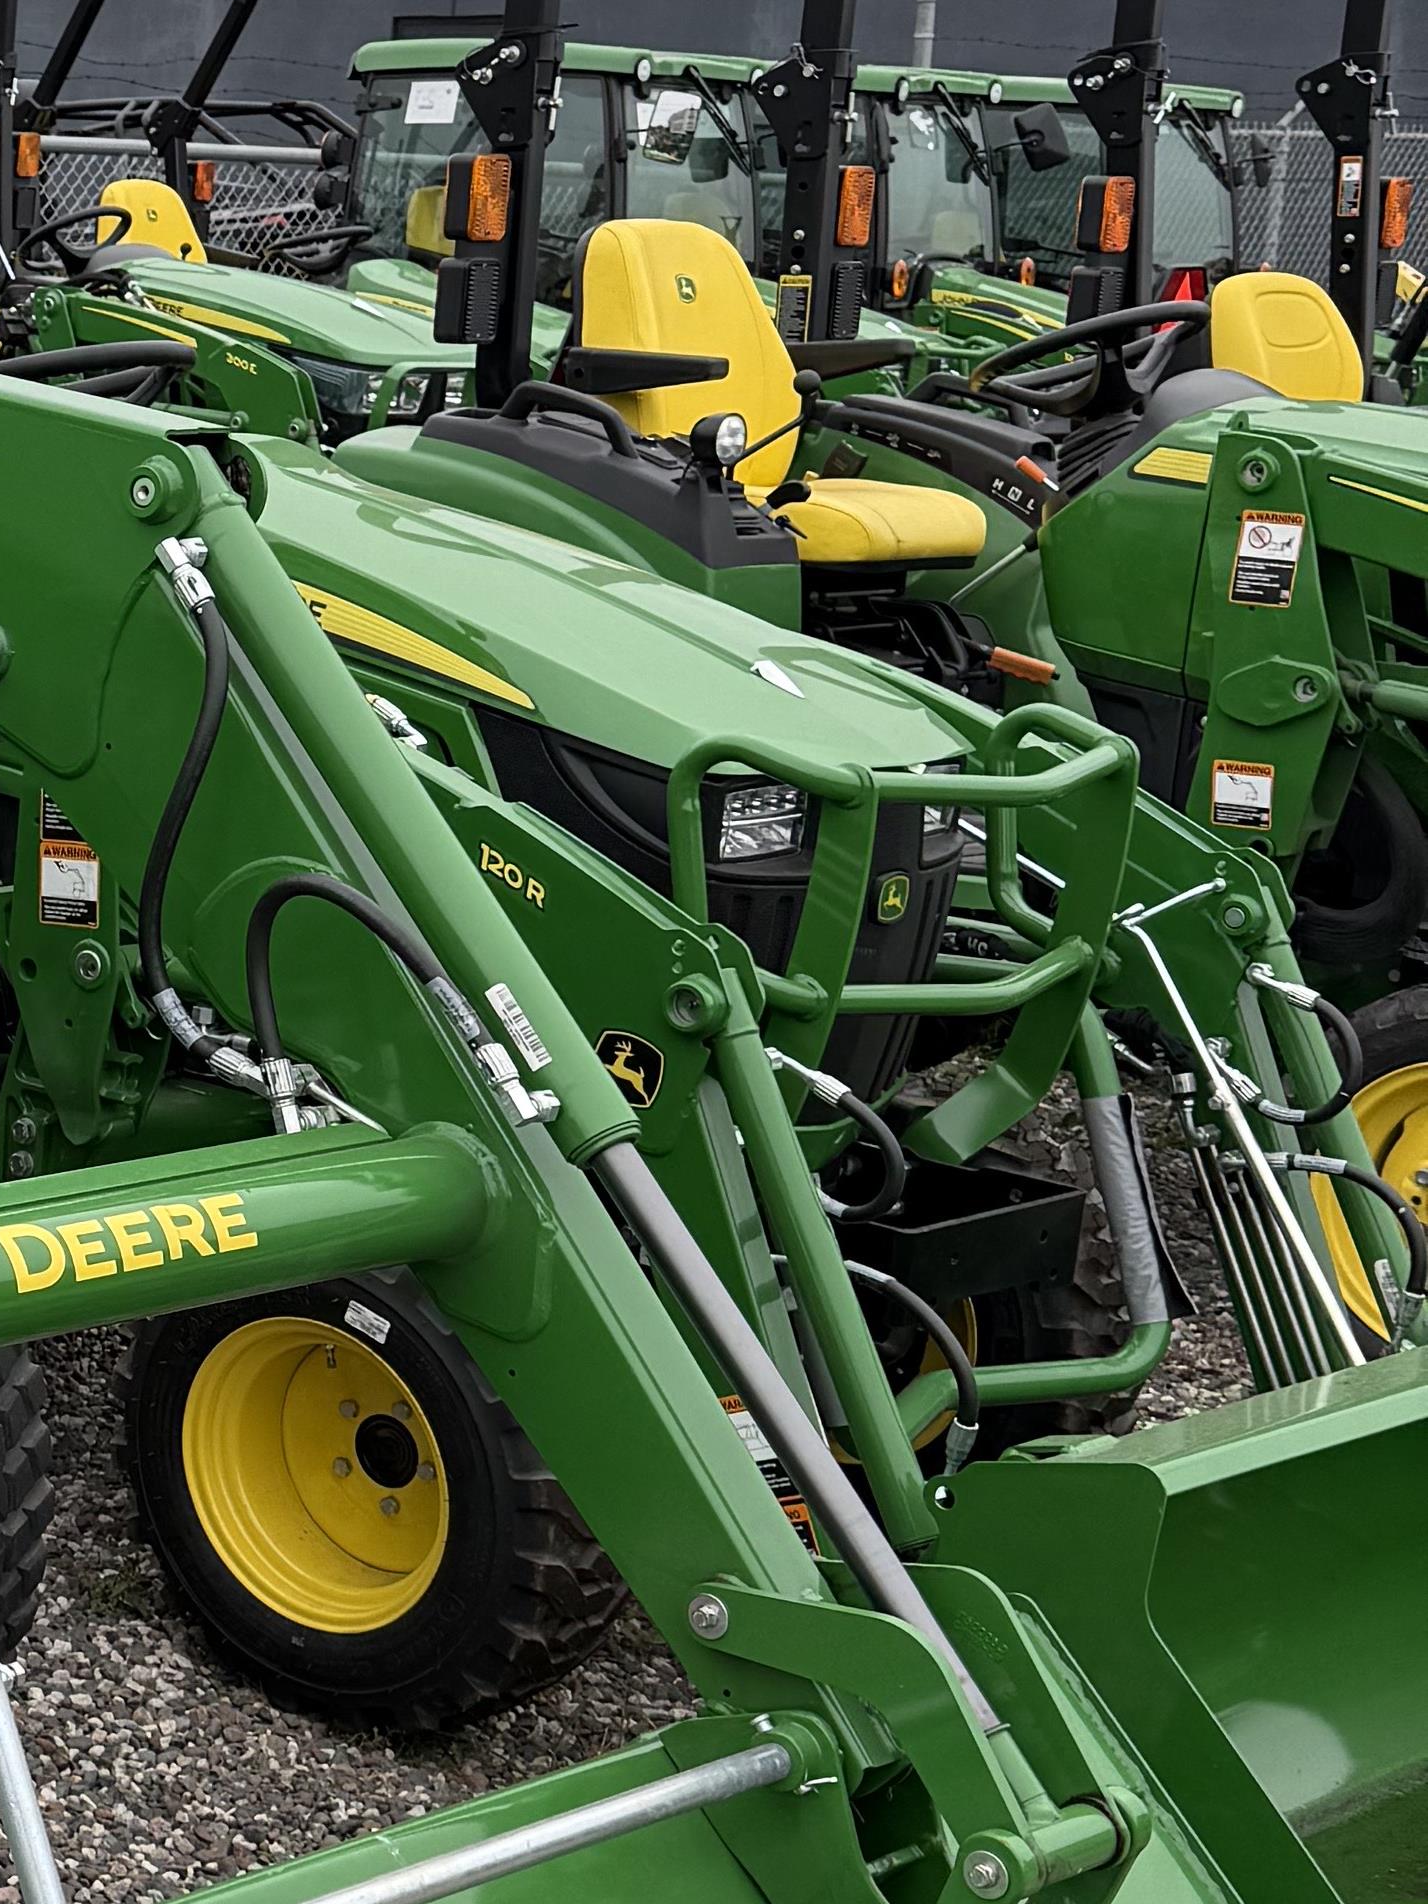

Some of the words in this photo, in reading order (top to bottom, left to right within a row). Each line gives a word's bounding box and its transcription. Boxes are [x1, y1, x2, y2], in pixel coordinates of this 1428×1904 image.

[1255, 512, 1304, 525] WARNING
[1226, 763, 1272, 776] WARNING
[480, 842, 523, 889] 120
[526, 876, 546, 909] R
